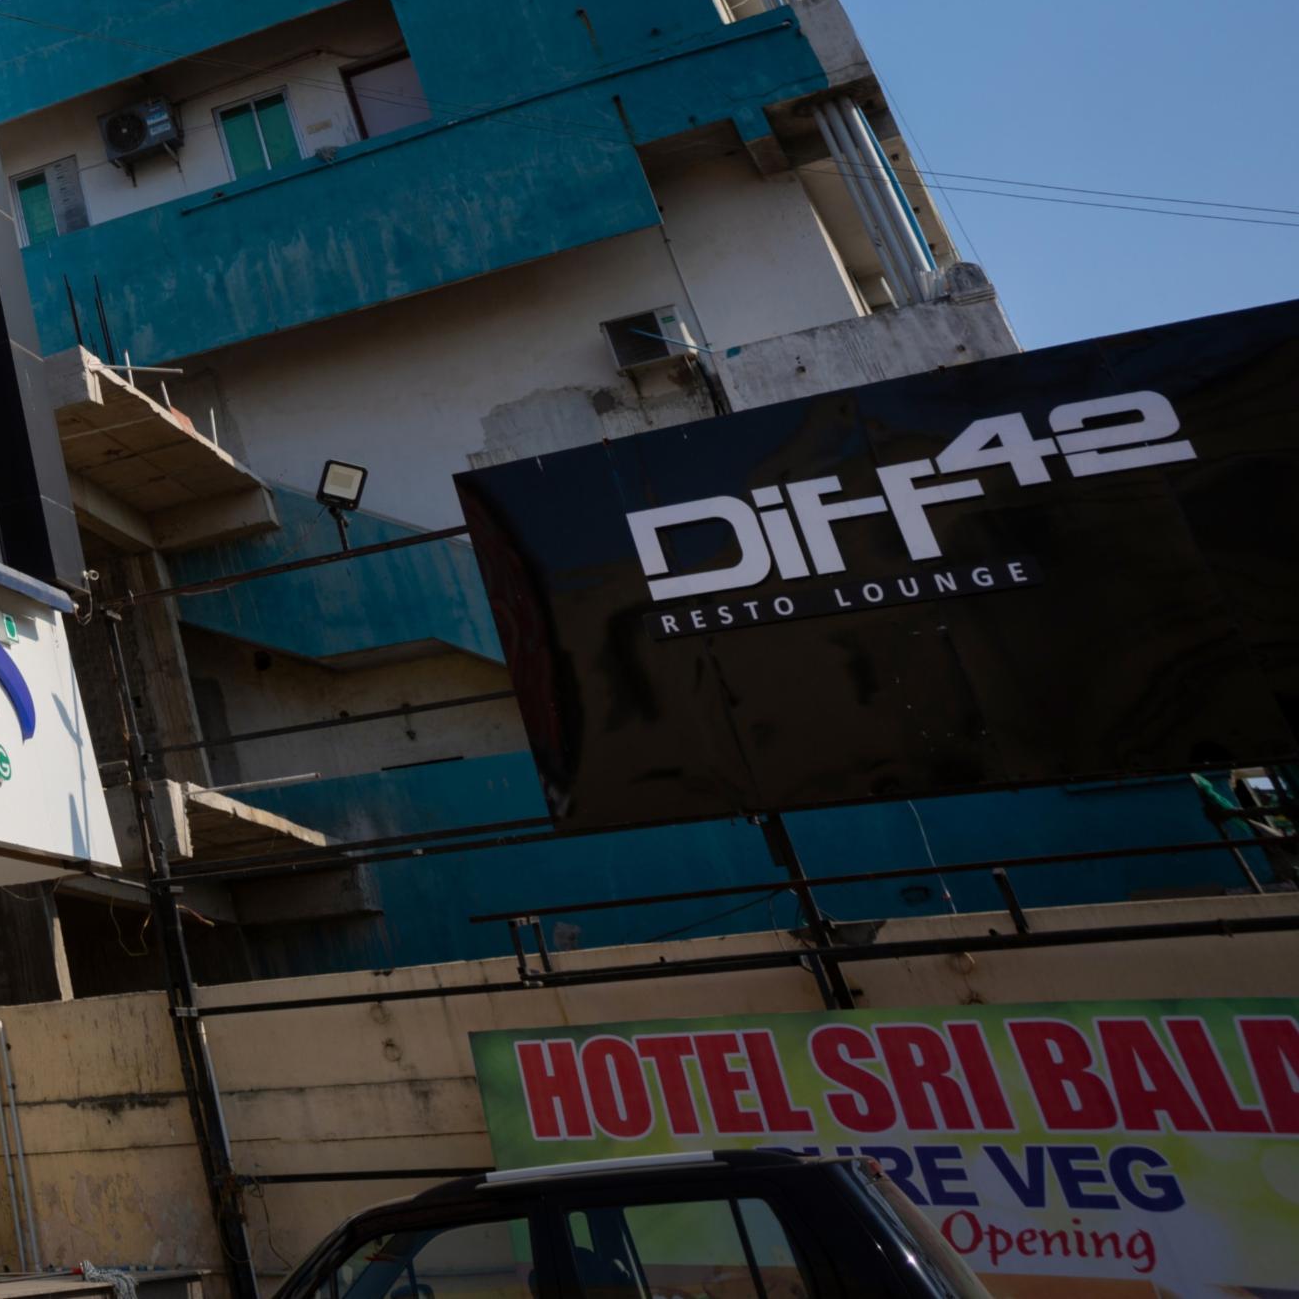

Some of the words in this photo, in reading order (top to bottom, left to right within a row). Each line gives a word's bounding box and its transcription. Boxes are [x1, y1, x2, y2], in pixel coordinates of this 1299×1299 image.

[661, 595, 796, 634] RESTO
[834, 561, 1032, 607] LOUNGE
[514, 1029, 815, 1142] HOTEL
[810, 1019, 1016, 1135] SRI
[983, 1145, 1185, 1212] VEG
[940, 1209, 1157, 1274] Opening
